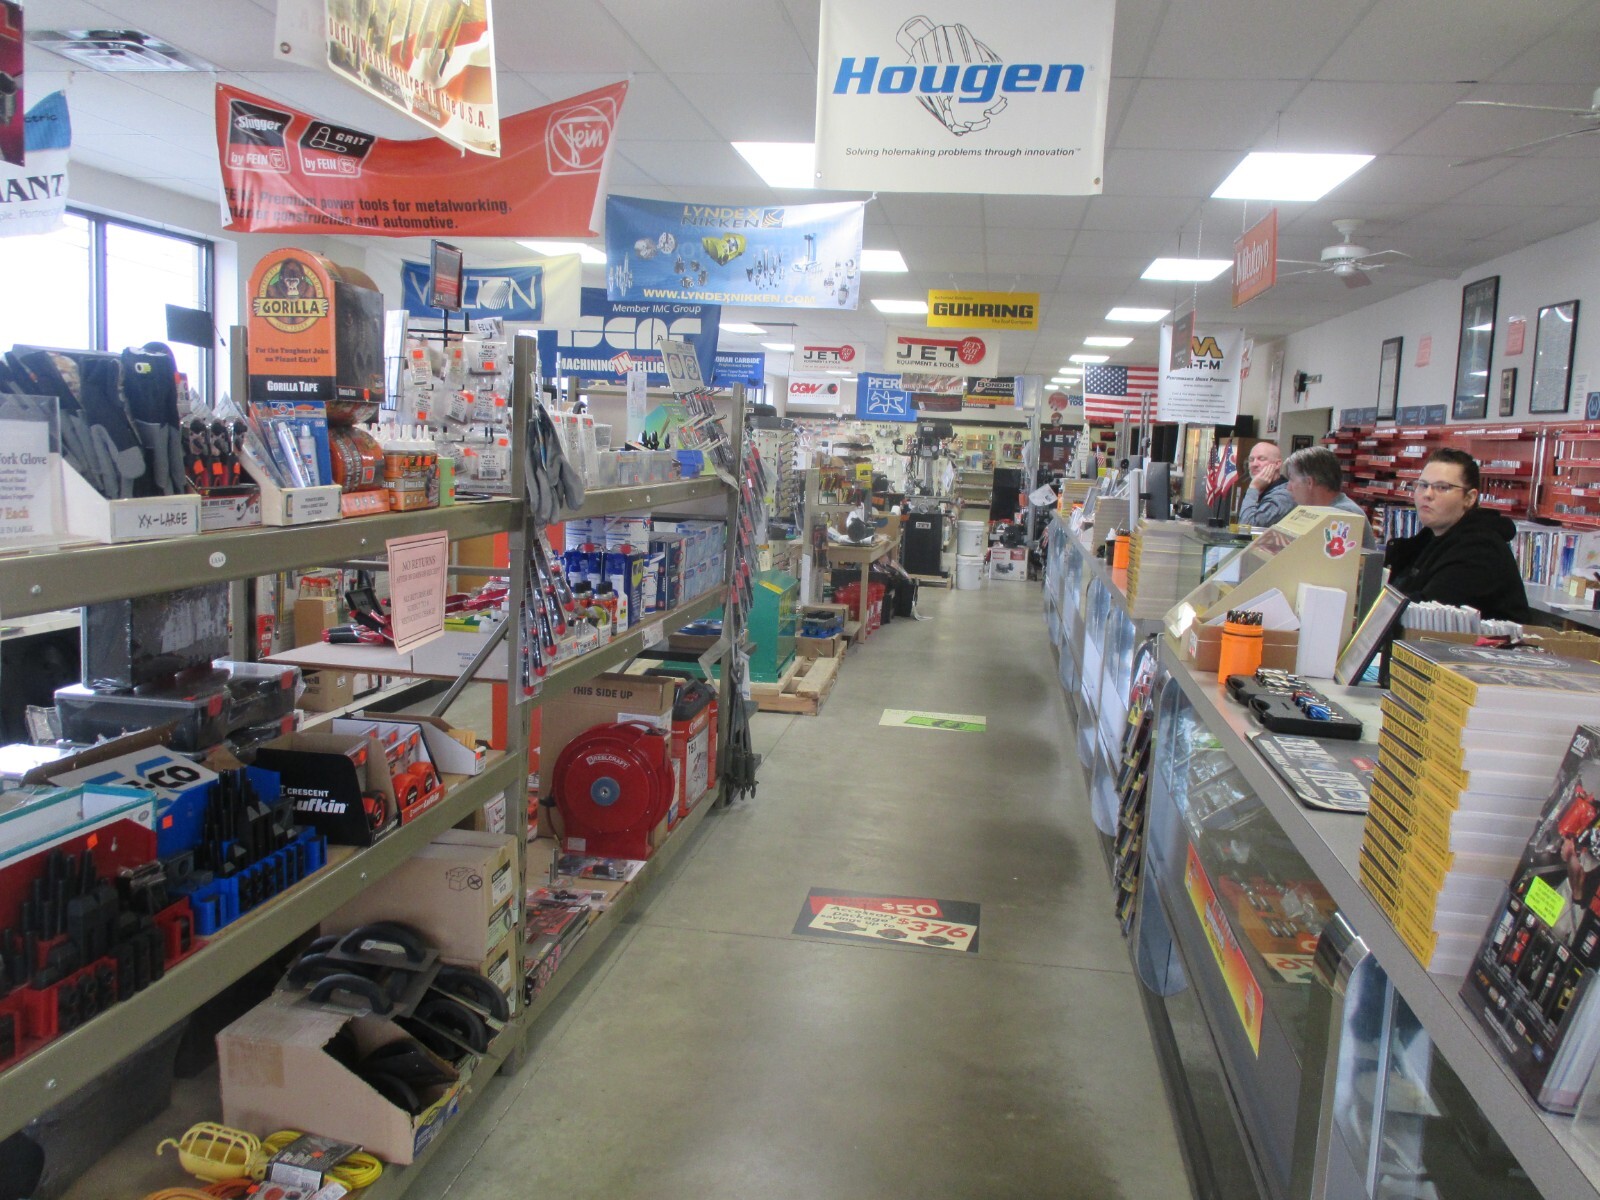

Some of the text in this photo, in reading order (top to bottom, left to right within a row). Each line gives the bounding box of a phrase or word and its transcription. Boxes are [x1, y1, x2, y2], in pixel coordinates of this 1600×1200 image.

[832, 56, 1085, 103] Hougen
[237, 116, 282, 131] Slugger
[336, 132, 367, 146] GRIT
[845, 147, 1074, 156] Solving holemaking problems through innovation
[231, 152, 268, 166] by FEIN
[305, 158, 337, 171] by FEIN
[0, 174, 64, 203] ANT
[260, 190, 315, 203] Premium
[321, 198, 354, 211] power
[359, 199, 389, 210] tools
[394, 199, 410, 211] for
[415, 199, 512, 214] metalworking.
[273, 209, 458, 229] construction and automotive.
[684, 205, 760, 220] LYNDEX
[681, 216, 759, 228] NIKKEN
[262, 301, 320, 315] GORILLA
[612, 304, 701, 315] Member IMC Group
[933, 303, 1034, 318] GUHRING
[804, 350, 840, 361] JET
[897, 344, 959, 362] JET
[267, 381, 318, 393] GORILLA TAPE
[868, 377, 902, 389] PFER
[1043, 434, 1075, 443] JET
[20, 453, 47, 465] Glove
[138, 512, 188, 528] XX-LARGE
[411, 555, 436, 570] RETURNS
[596, 688, 617, 697] SIDE
[621, 690, 633, 700] UP
[287, 787, 329, 798] CRESCENT
[293, 799, 346, 814] ufkin
[830, 905, 897, 920] Accessory
[881, 902, 938, 916] $50
[821, 914, 861, 924] savings
[832, 911, 968, 938] package $376
